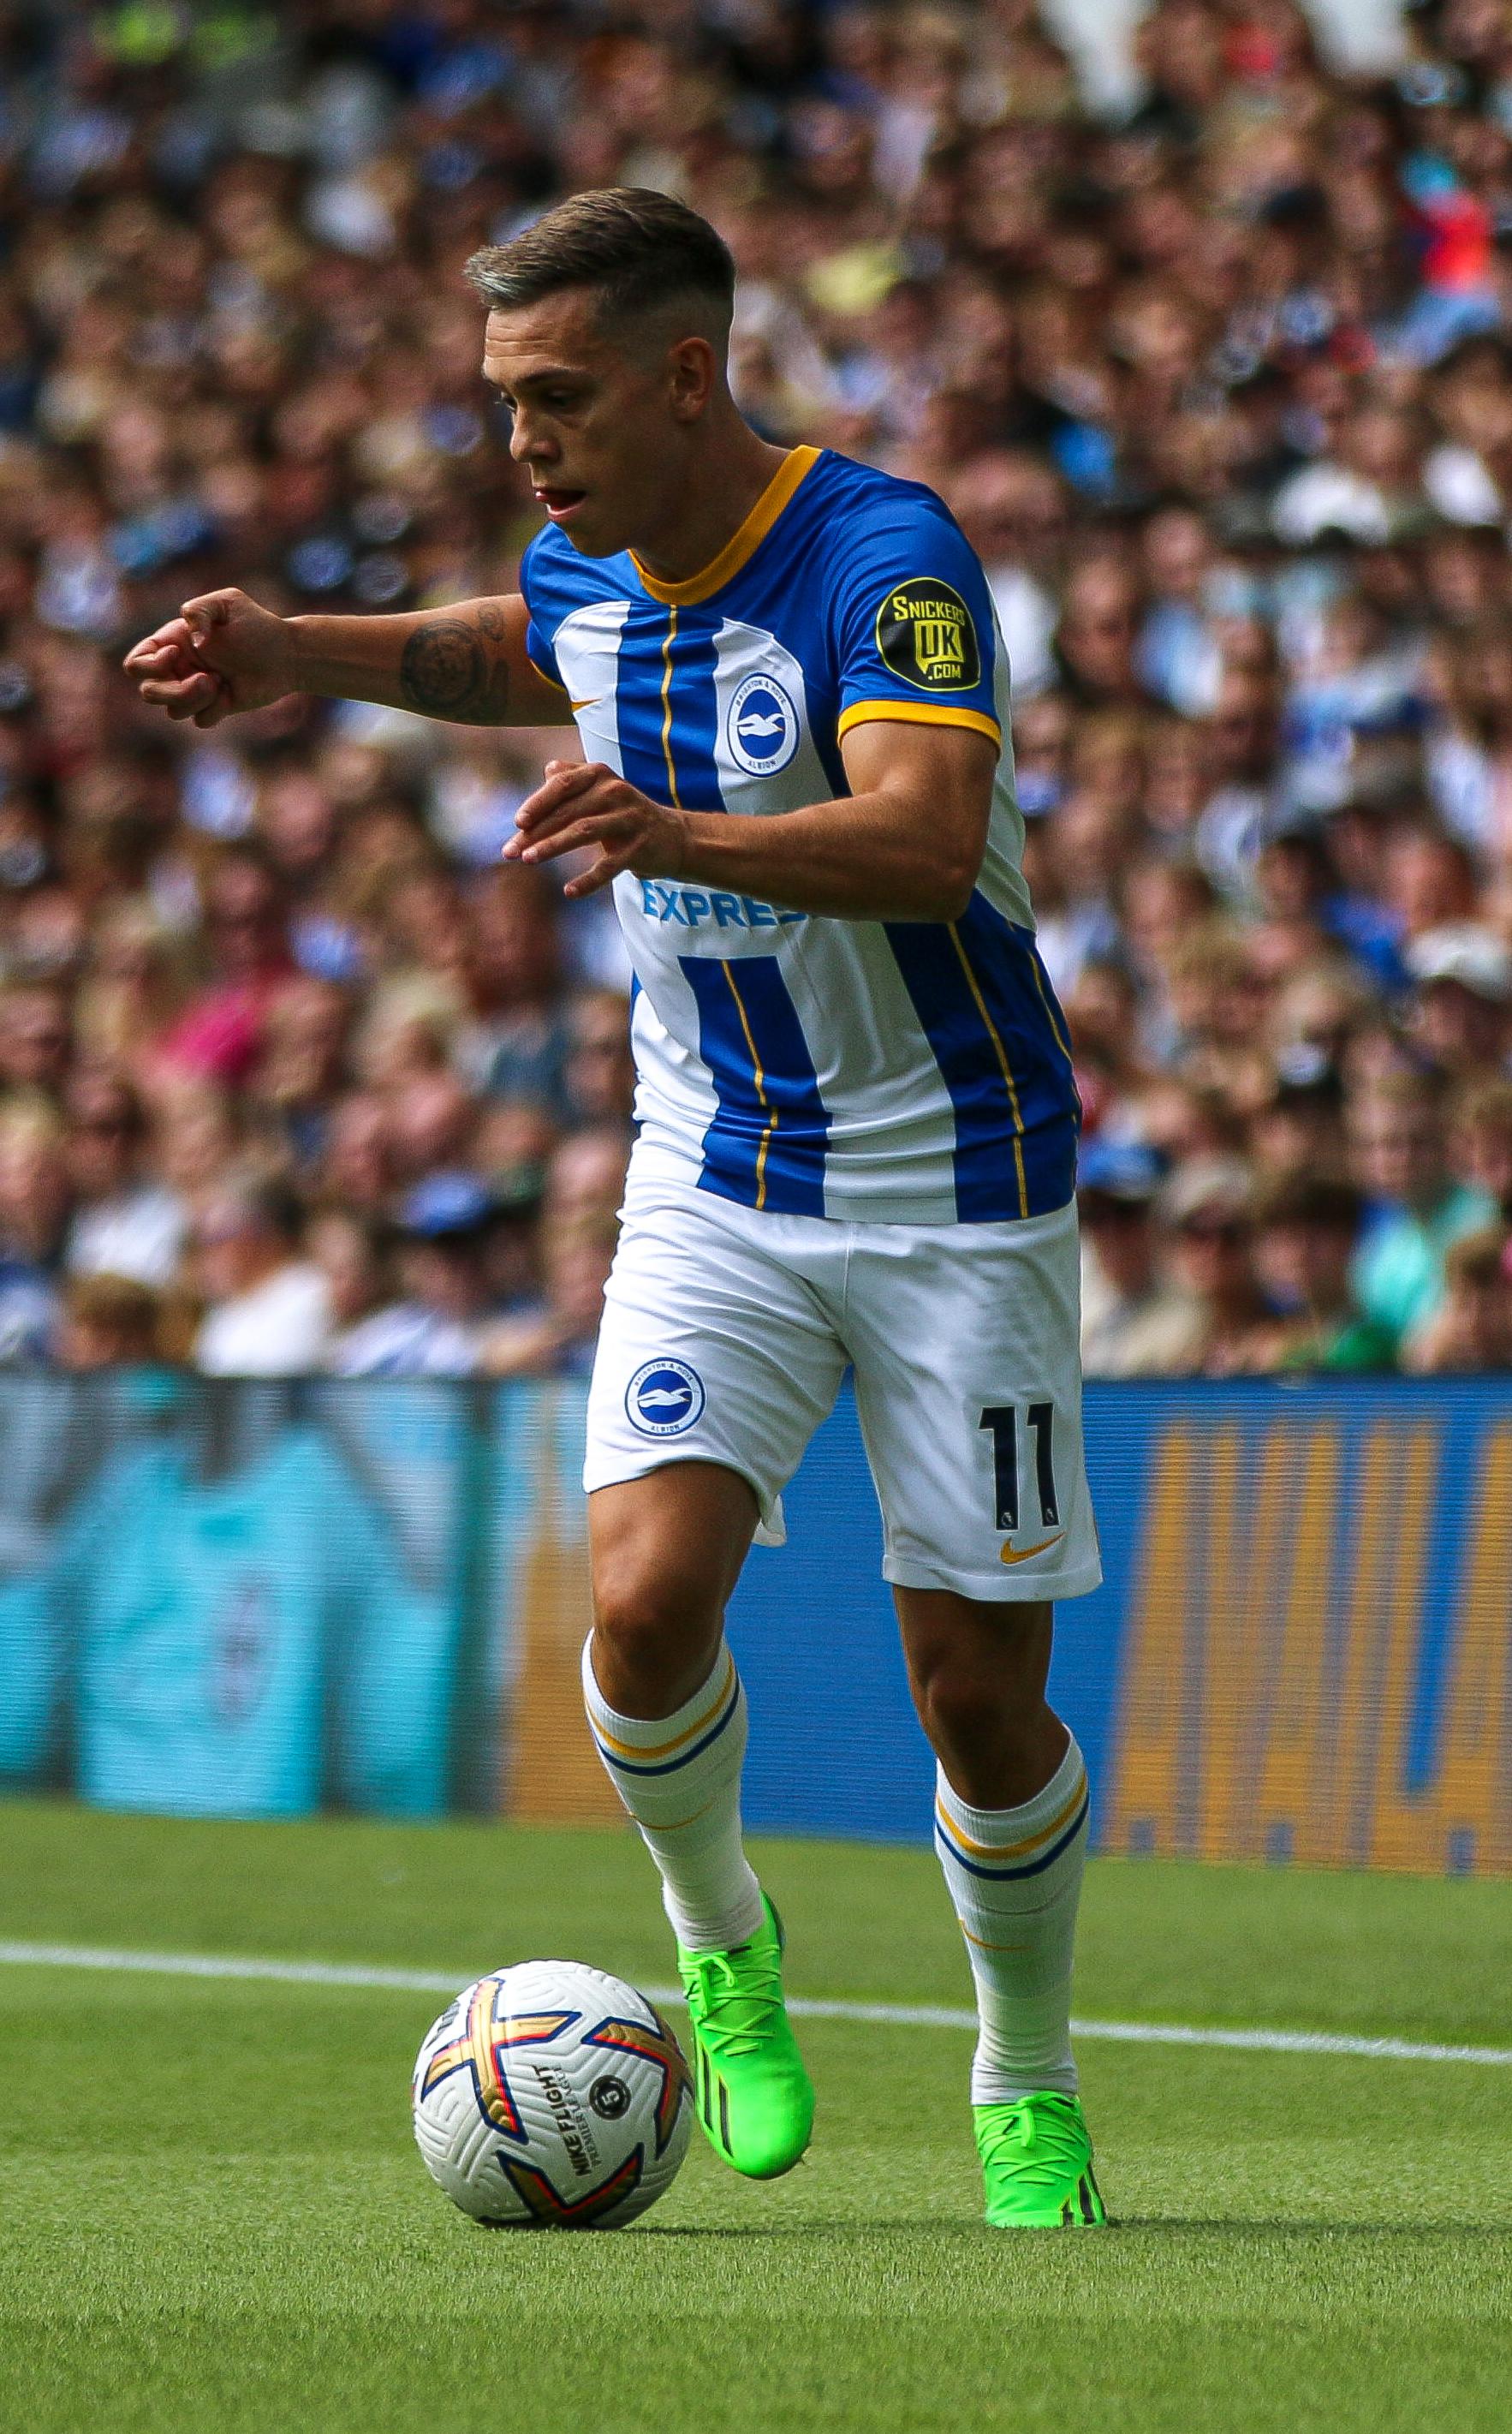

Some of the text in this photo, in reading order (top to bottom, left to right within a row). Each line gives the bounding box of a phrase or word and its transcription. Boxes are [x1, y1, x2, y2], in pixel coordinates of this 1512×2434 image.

[892, 596, 966, 626] SNICKERS
[920, 624, 959, 659] UK
[927, 664, 961, 681] .COM
[748, 759, 777, 770] ALBION
[978, 1401, 1061, 1532] 11
[532, 2065, 593, 2176] NIKE FLIGHT
